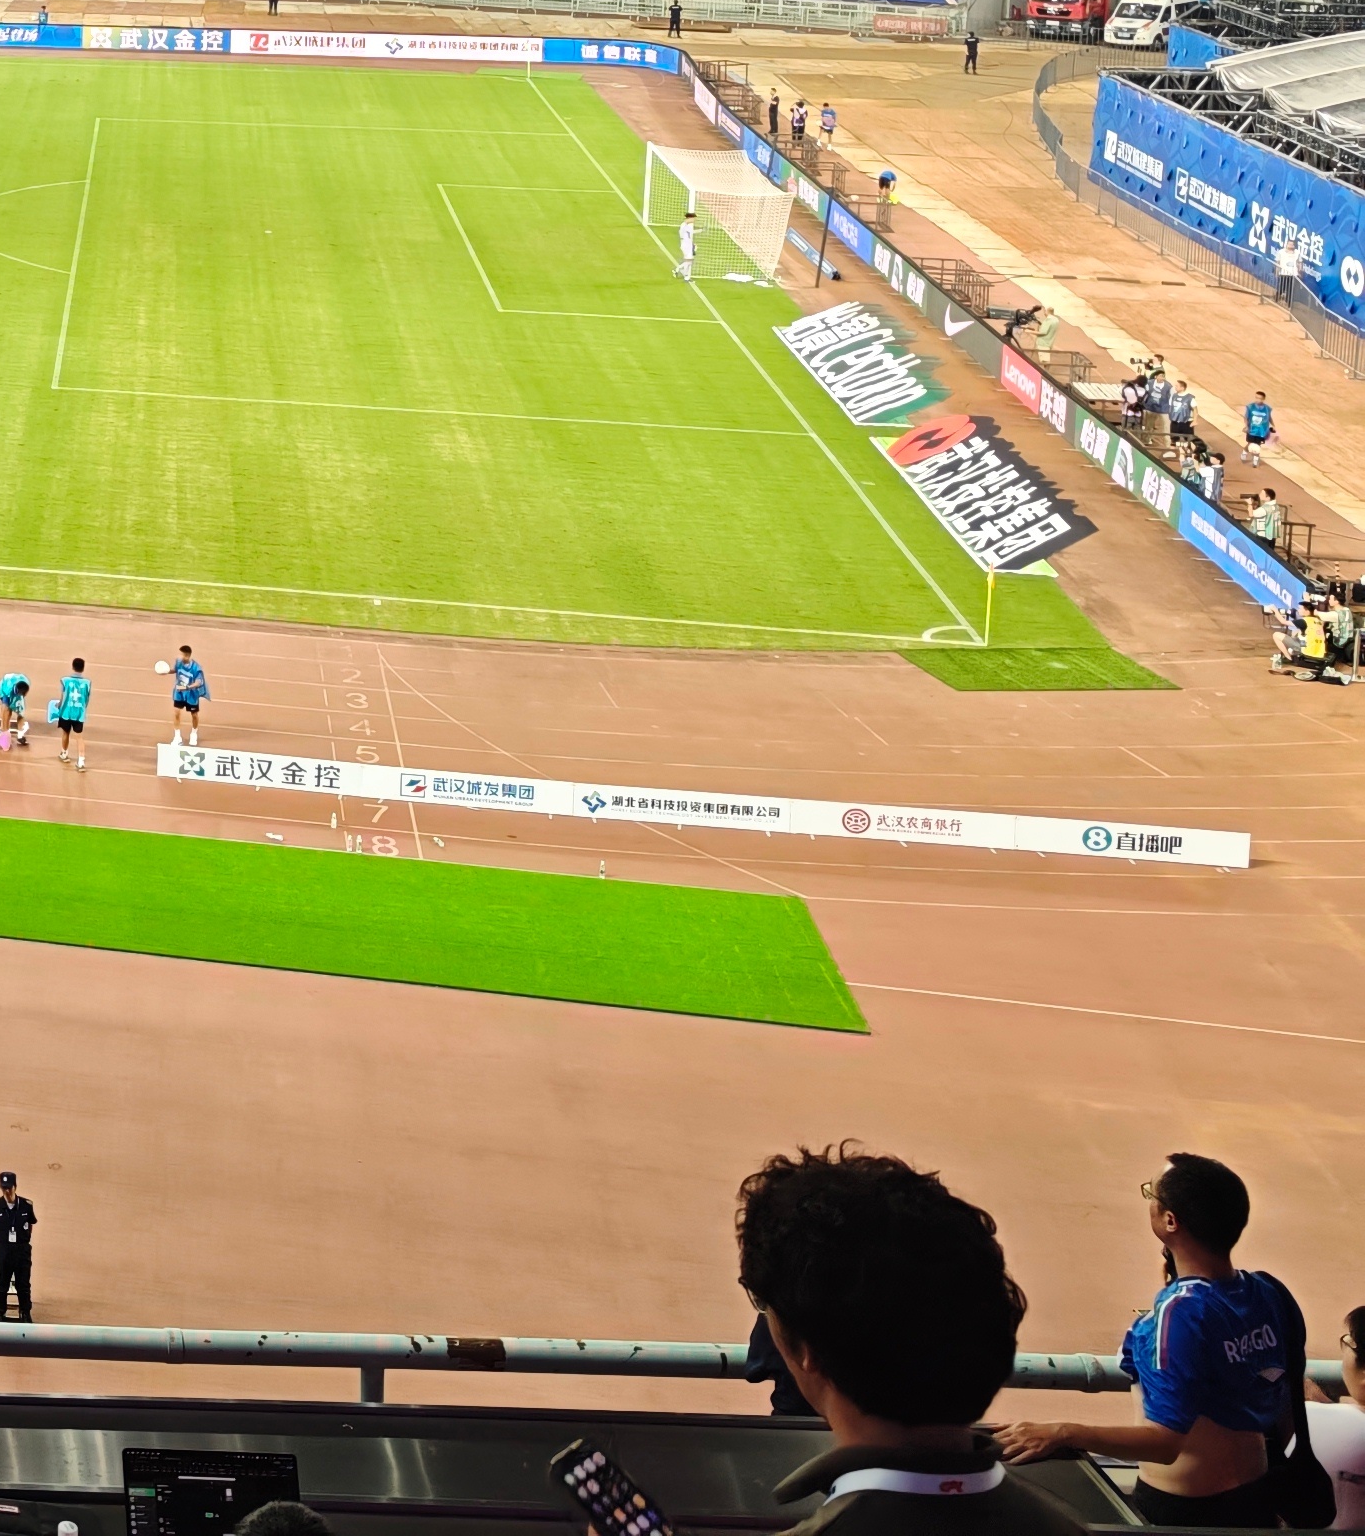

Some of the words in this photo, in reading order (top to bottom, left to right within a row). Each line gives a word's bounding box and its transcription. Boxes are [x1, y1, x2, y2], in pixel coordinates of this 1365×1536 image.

[119, 27, 224, 52] 武汉金控
[1116, 140, 1164, 183] 武汉城建集团
[1271, 214, 1325, 268] 武汉金控
[1003, 353, 1038, 402] Lenovo
[1040, 379, 1067, 434] 联想
[341, 669, 365, 684] 2
[345, 691, 370, 710] 3
[348, 718, 376, 736] 4
[355, 745, 381, 764] 5
[214, 754, 342, 790] 武汉金控
[432, 776, 536, 801] 武汉城发集团
[362, 803, 390, 824] 7
[610, 794, 781, 819] 湖北省科技投资集团有限公司
[876, 812, 963, 833] 武汉农商银行
[371, 834, 400, 857] 8
[1115, 830, 1183, 856] 直播吧
